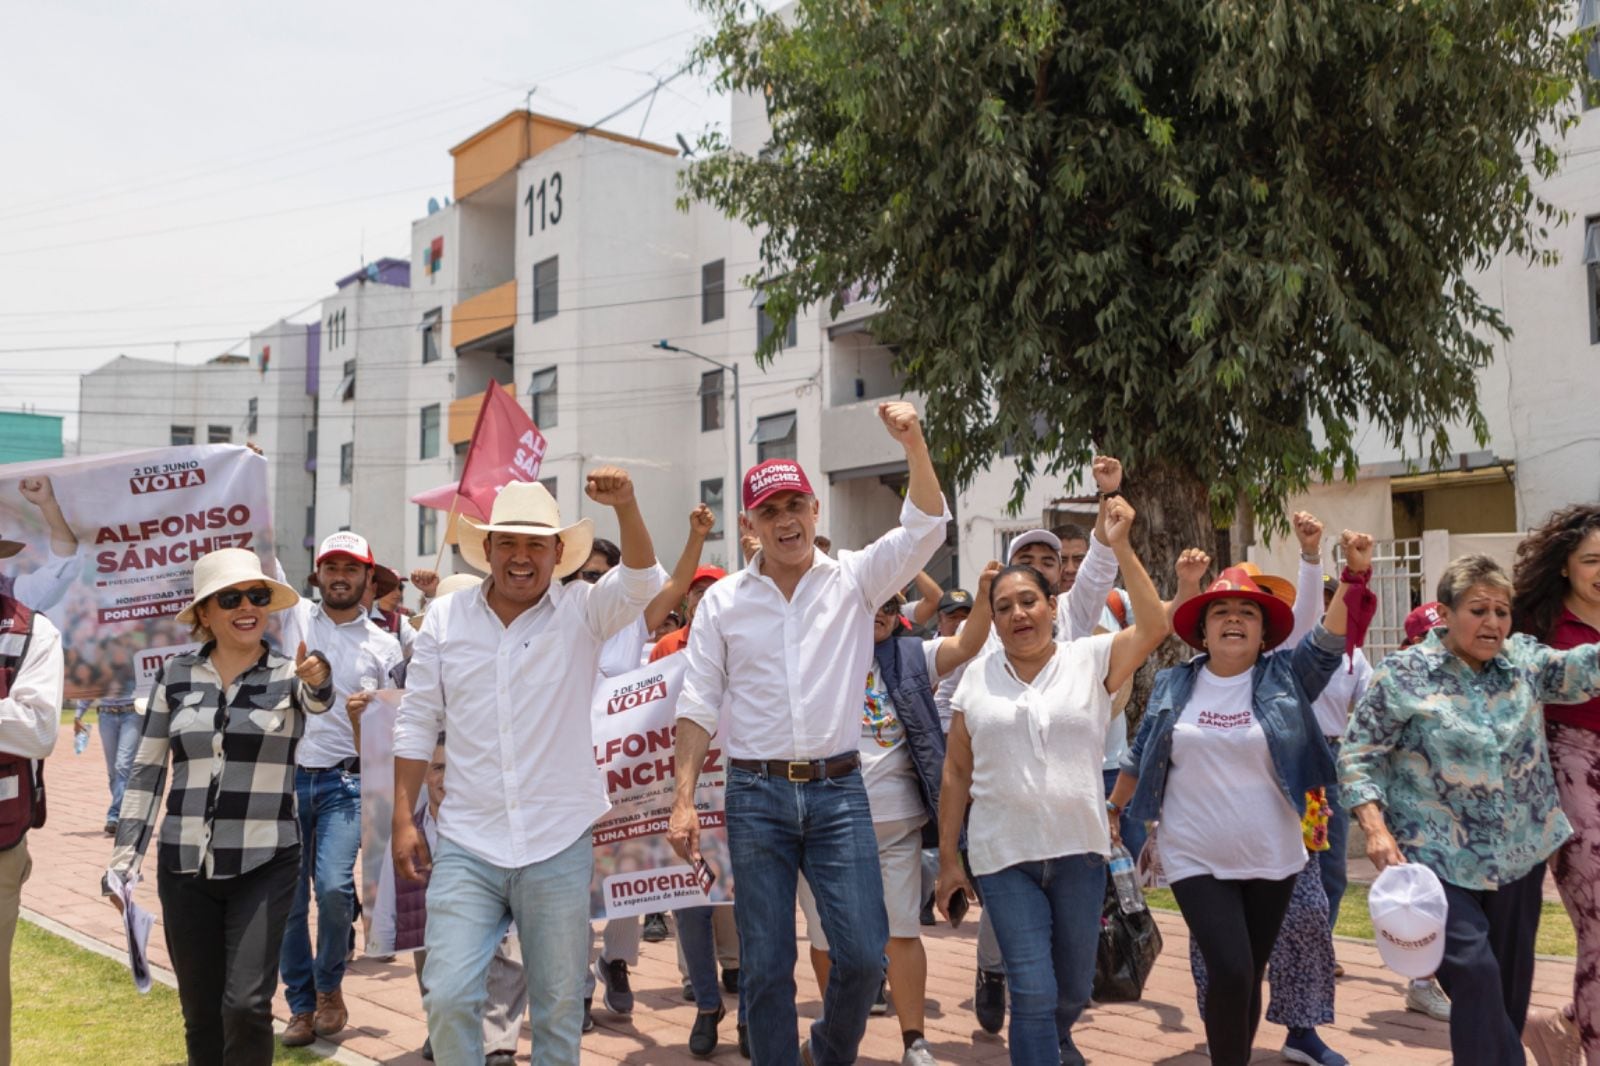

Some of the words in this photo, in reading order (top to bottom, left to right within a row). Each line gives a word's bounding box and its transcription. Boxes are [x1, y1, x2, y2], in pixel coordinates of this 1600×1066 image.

[524, 172, 562, 236] 113
[327, 307, 346, 351] 111
[134, 468, 141, 476] 2
[144, 465, 160, 475] DE
[163, 460, 198, 473] JUNIO
[750, 464, 797, 484] ALFONSO
[132, 471, 202, 493] VOTA
[95, 504, 250, 544] ALFONSO
[96, 532, 254, 573] SÁNCHEZ
[108, 576, 154, 586] PRESIDENTE
[156, 569, 194, 580] MUNICIPA
[116, 591, 174, 605] HONESTIDAD
[104, 609, 130, 621] POR
[132, 606, 158, 616] UNA
[161, 600, 193, 613] MEJO
[613, 688, 619, 697] 2
[620, 684, 633, 694] DE
[635, 674, 663, 691] JUNIO
[610, 685, 663, 713] VOTA
[643, 810, 649, 818] Y
[600, 831, 626, 842] UNA
[629, 822, 669, 835] MEJOR
[611, 872, 698, 898] morena
[624, 896, 660, 906] esperanza
[674, 889, 700, 898] México
